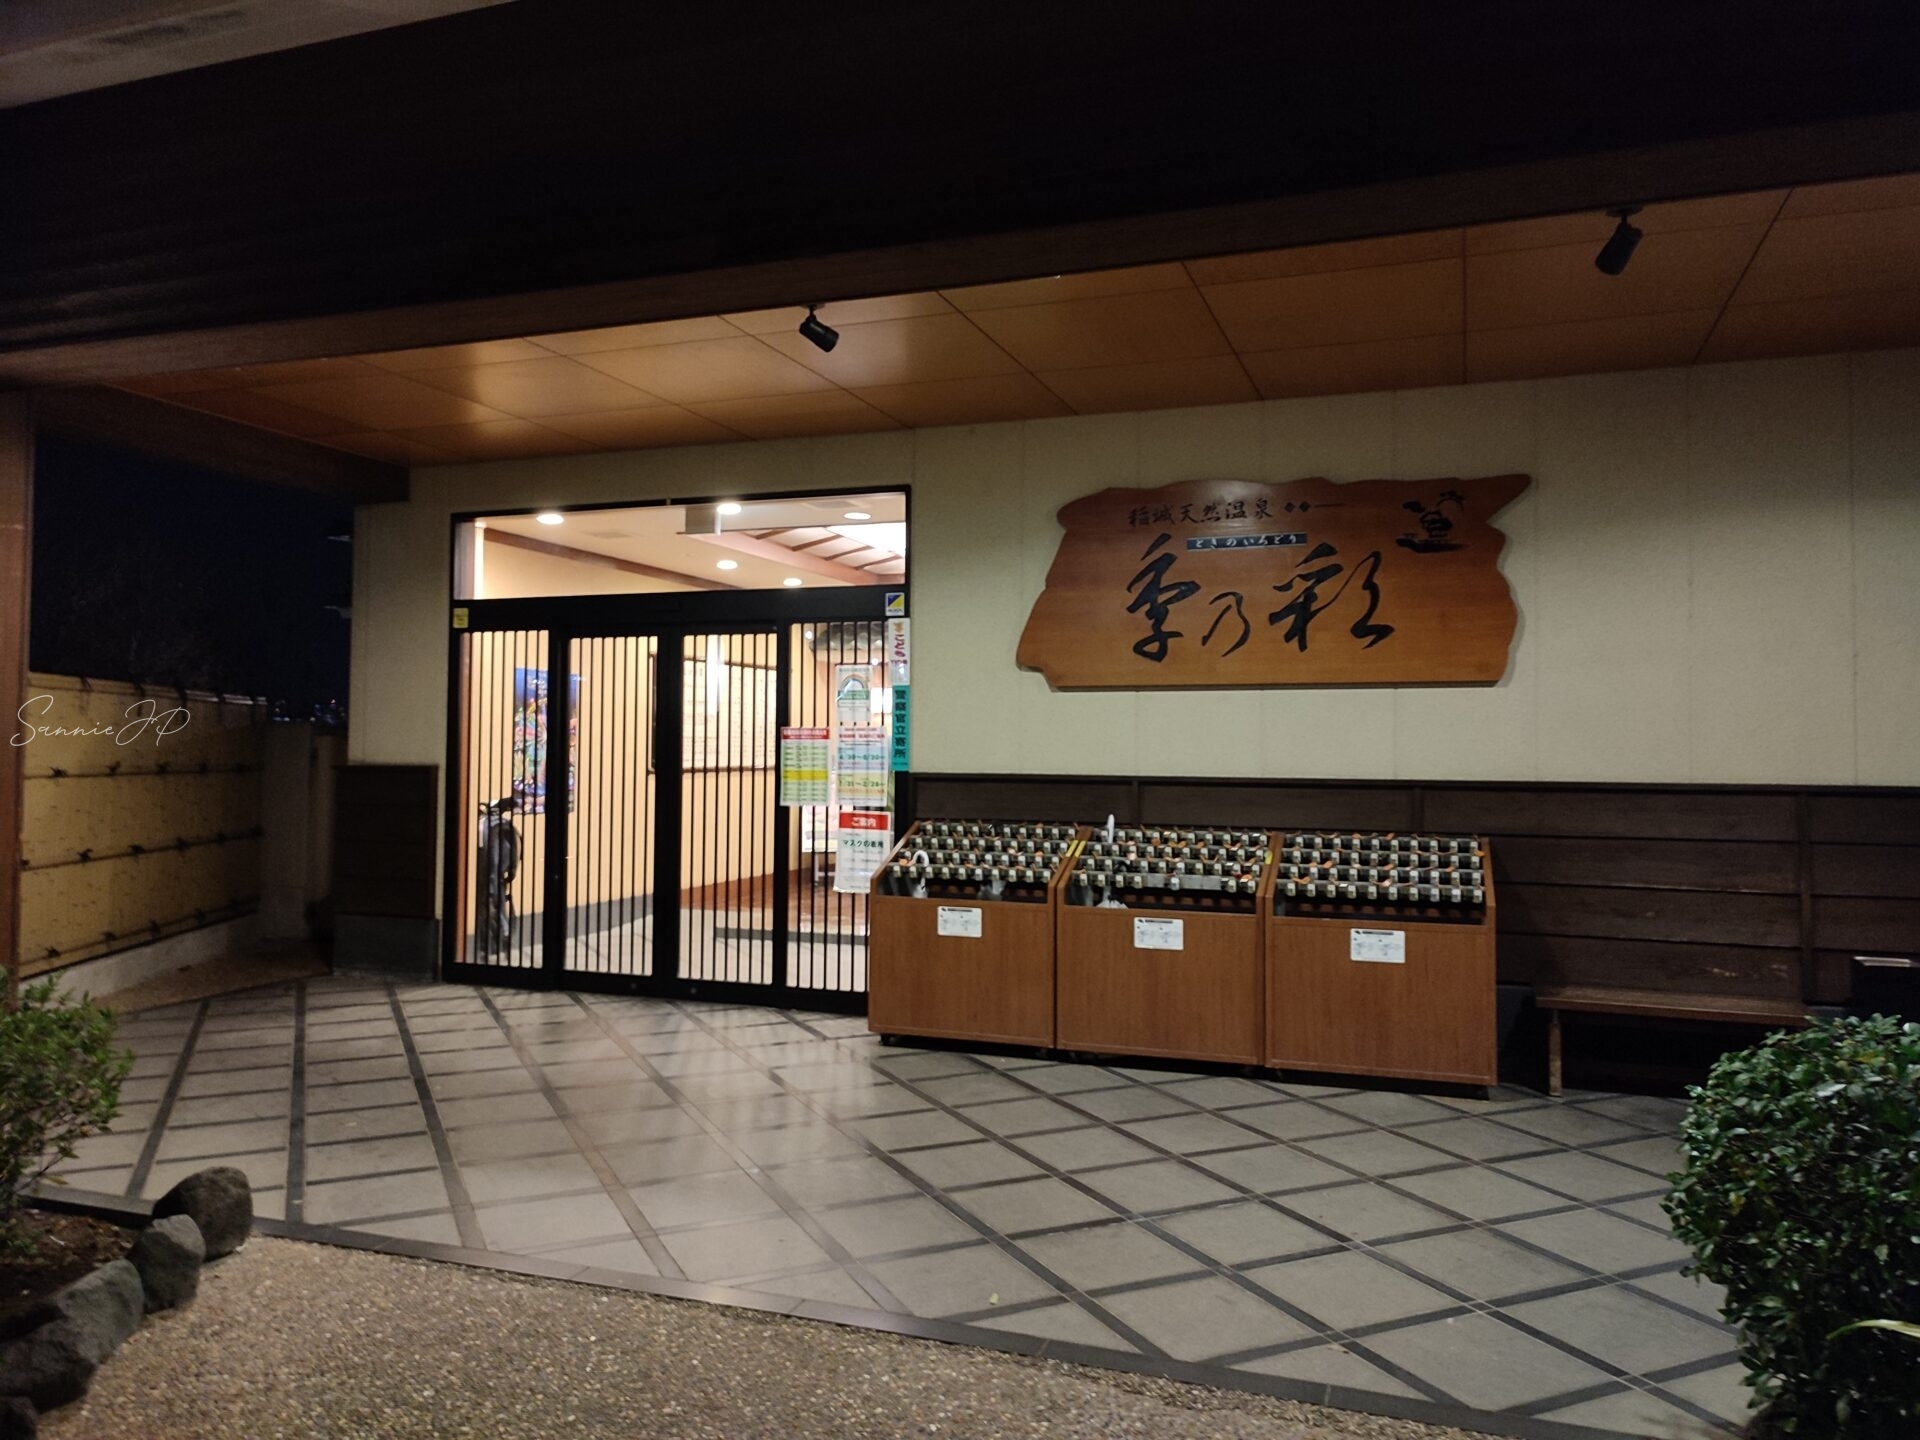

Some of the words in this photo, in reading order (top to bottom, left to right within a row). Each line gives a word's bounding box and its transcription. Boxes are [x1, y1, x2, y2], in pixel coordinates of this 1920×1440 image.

[1128, 500, 1273, 527] 稲城天然温泉
[1126, 532, 1395, 663] 季乃彩
